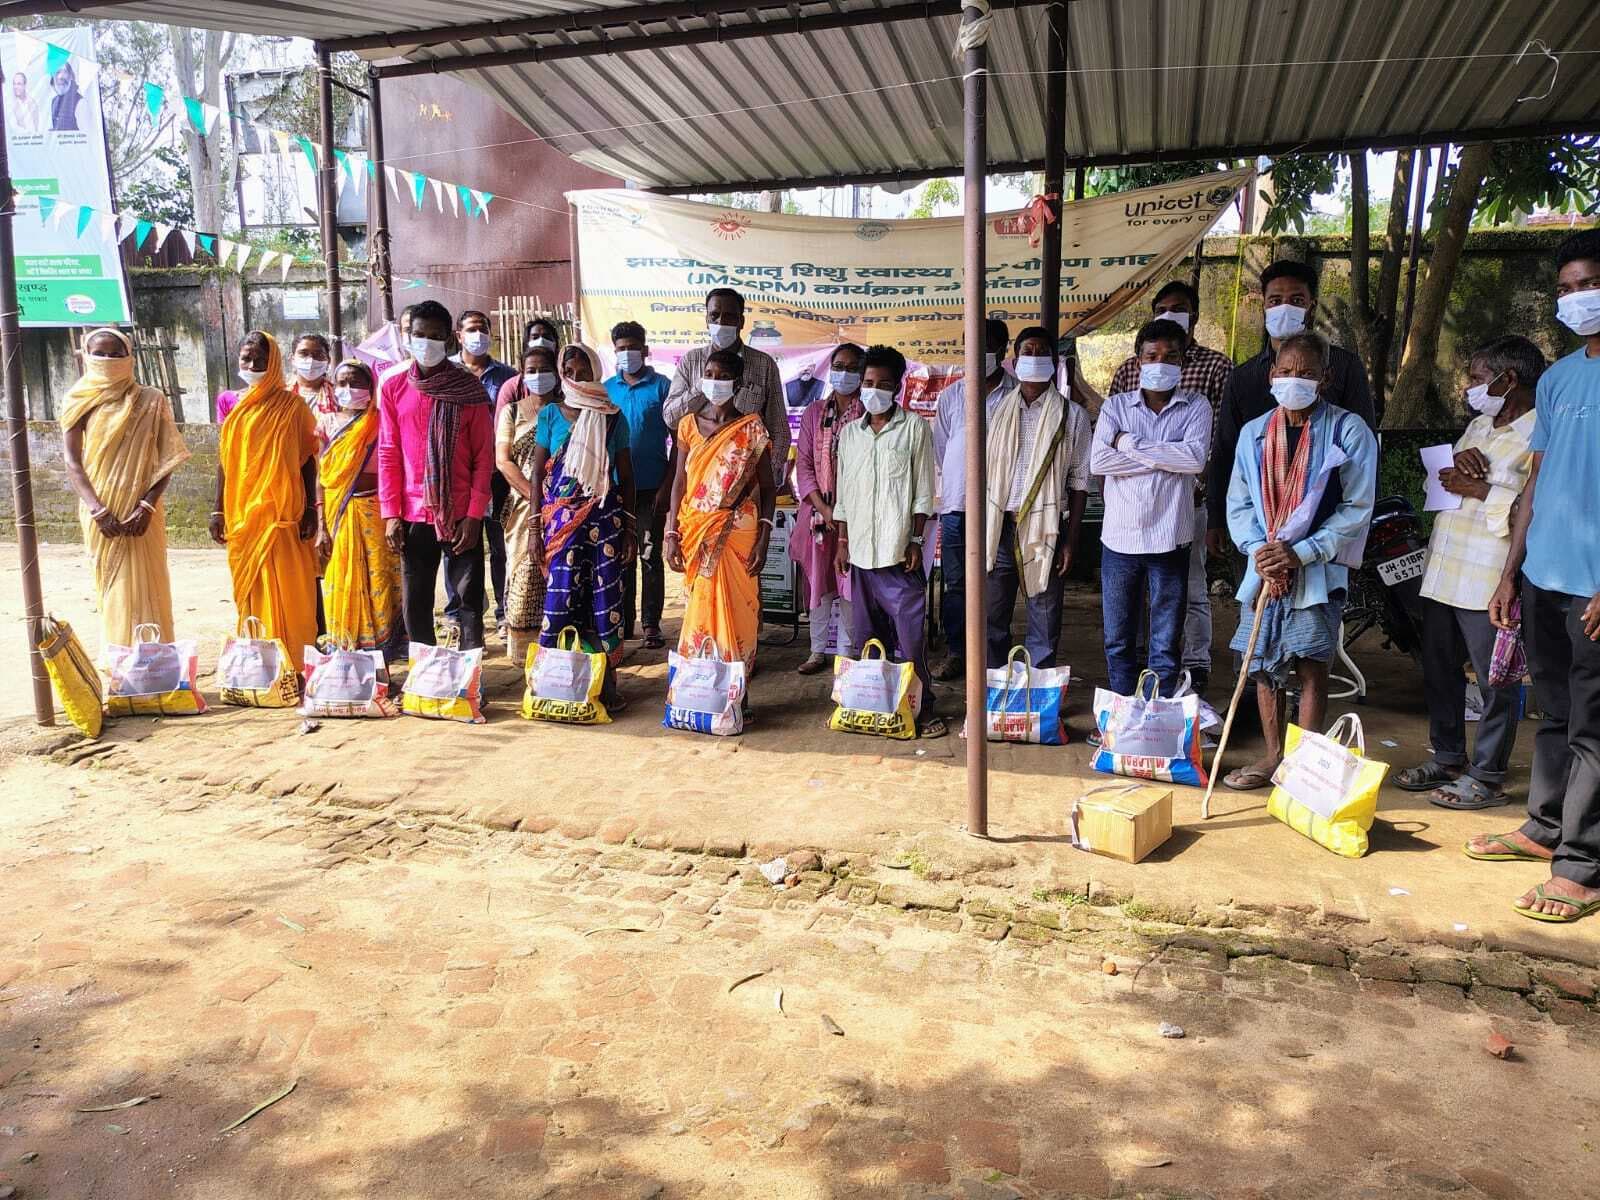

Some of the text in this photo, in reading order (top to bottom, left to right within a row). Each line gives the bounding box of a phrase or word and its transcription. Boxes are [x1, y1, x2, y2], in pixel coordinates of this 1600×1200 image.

[1124, 190, 1204, 217] unicef
[1127, 218, 1149, 227] for
[1152, 215, 1193, 226] every
[734, 264, 784, 280] मातृ
[790, 262, 849, 283] शिशु
[854, 266, 954, 279] स्वास्थ्य
[1011, 256, 1092, 271] पोण
[813, 281, 926, 297] कार्यक्रम
[862, 316, 889, 324] का
[895, 312, 965, 322] आयोज
[1394, 565, 1422, 581] 6577
